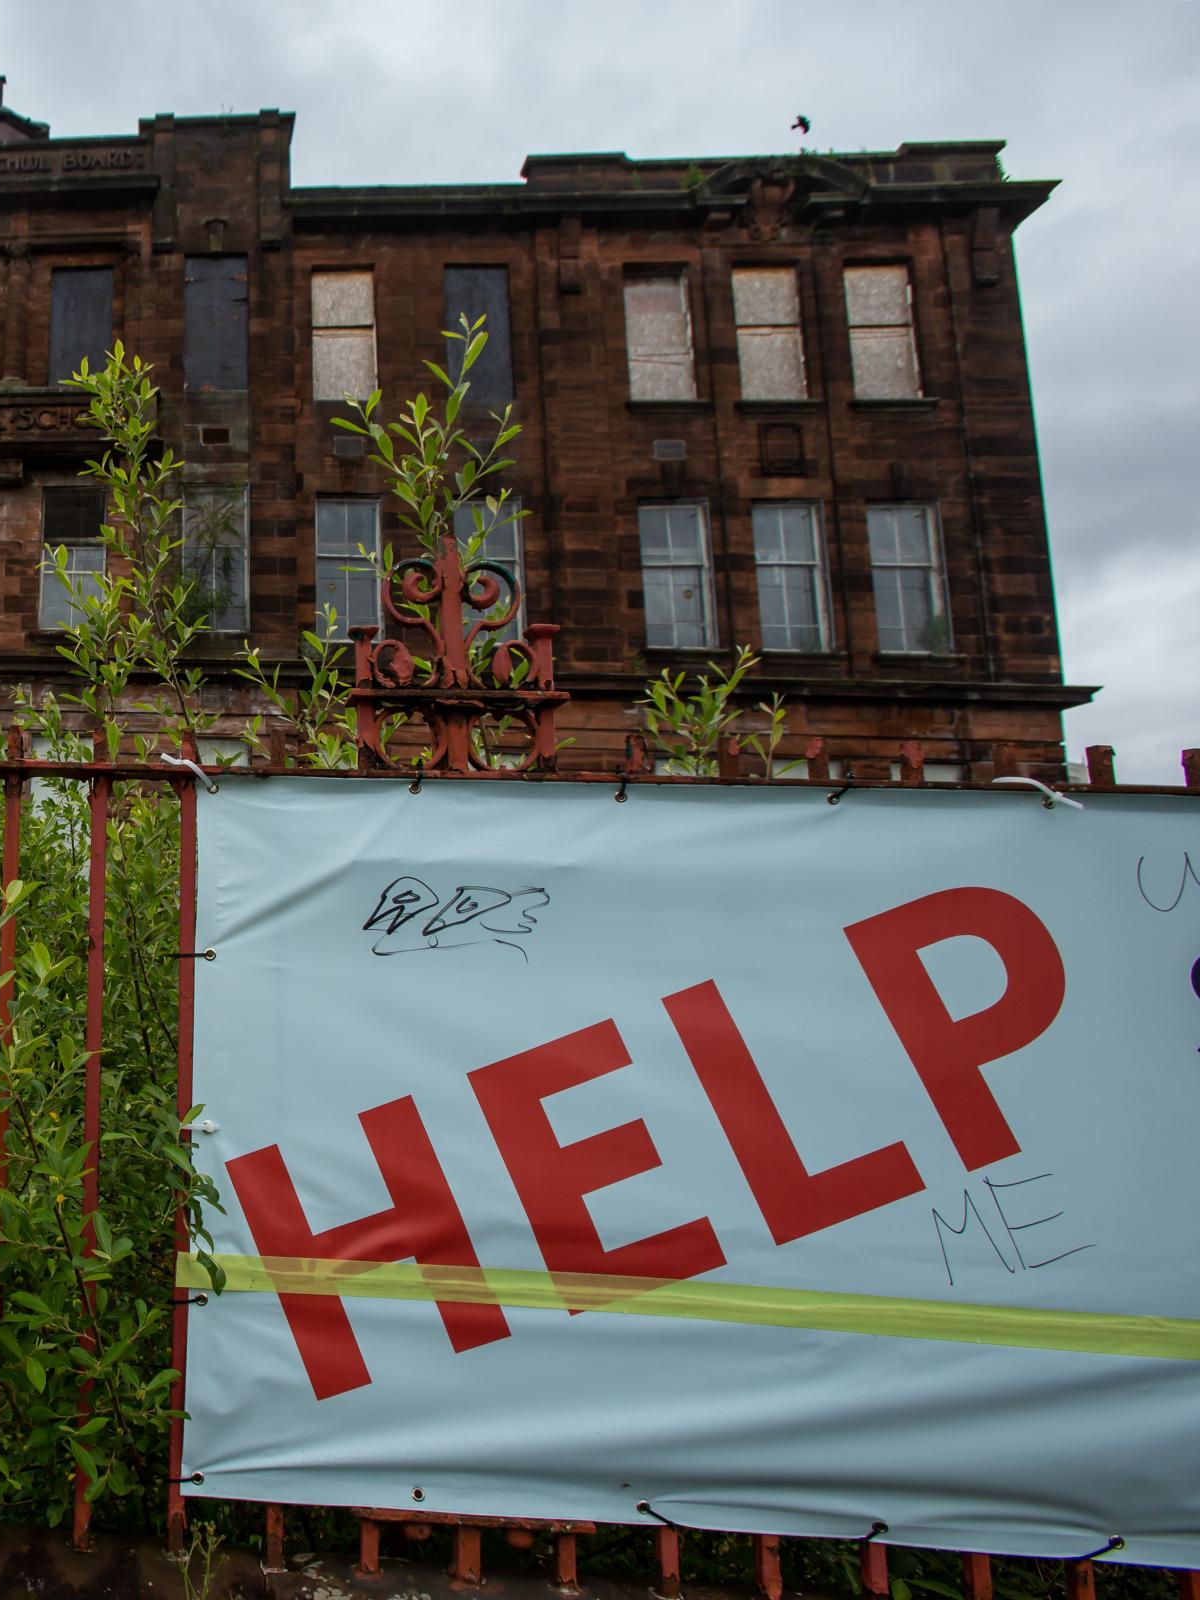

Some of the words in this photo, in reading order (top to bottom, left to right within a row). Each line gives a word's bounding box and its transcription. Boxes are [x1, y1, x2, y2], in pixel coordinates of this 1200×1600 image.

[61, 150, 133, 172] BOARD
[16, 406, 106, 430] SCHO
[225, 886, 1066, 1401] HELP
[931, 1172, 1098, 1286] ME
